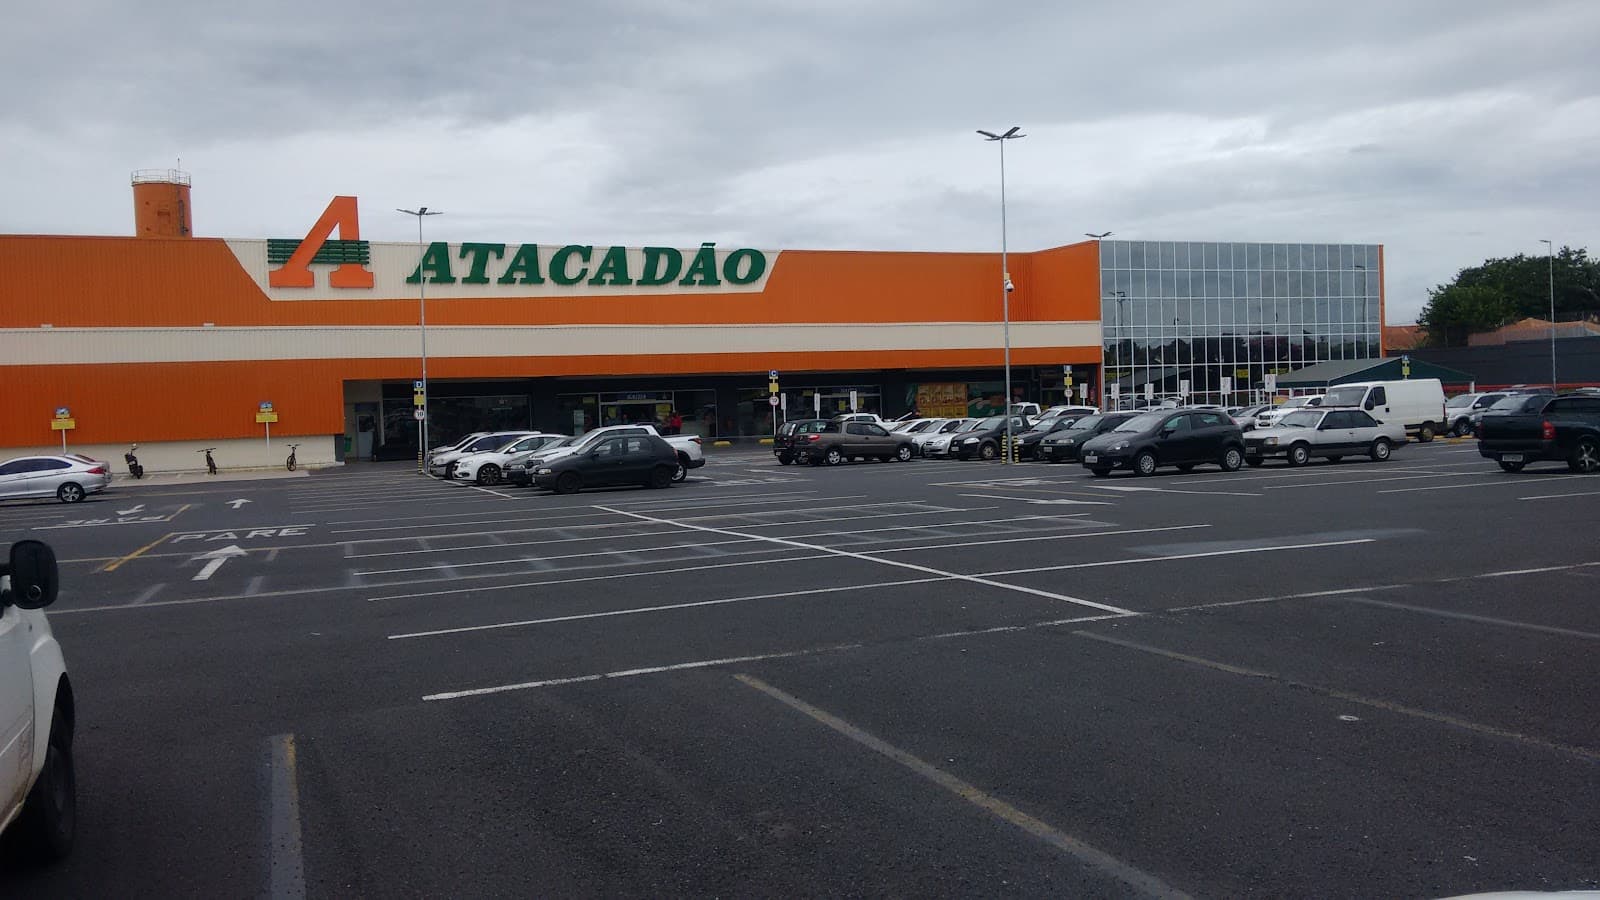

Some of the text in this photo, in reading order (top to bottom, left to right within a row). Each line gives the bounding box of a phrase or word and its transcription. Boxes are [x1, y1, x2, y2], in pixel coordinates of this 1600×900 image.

[268, 195, 375, 289] A
[406, 242, 767, 287] ATACADÃO
[170, 528, 311, 544] PARE
